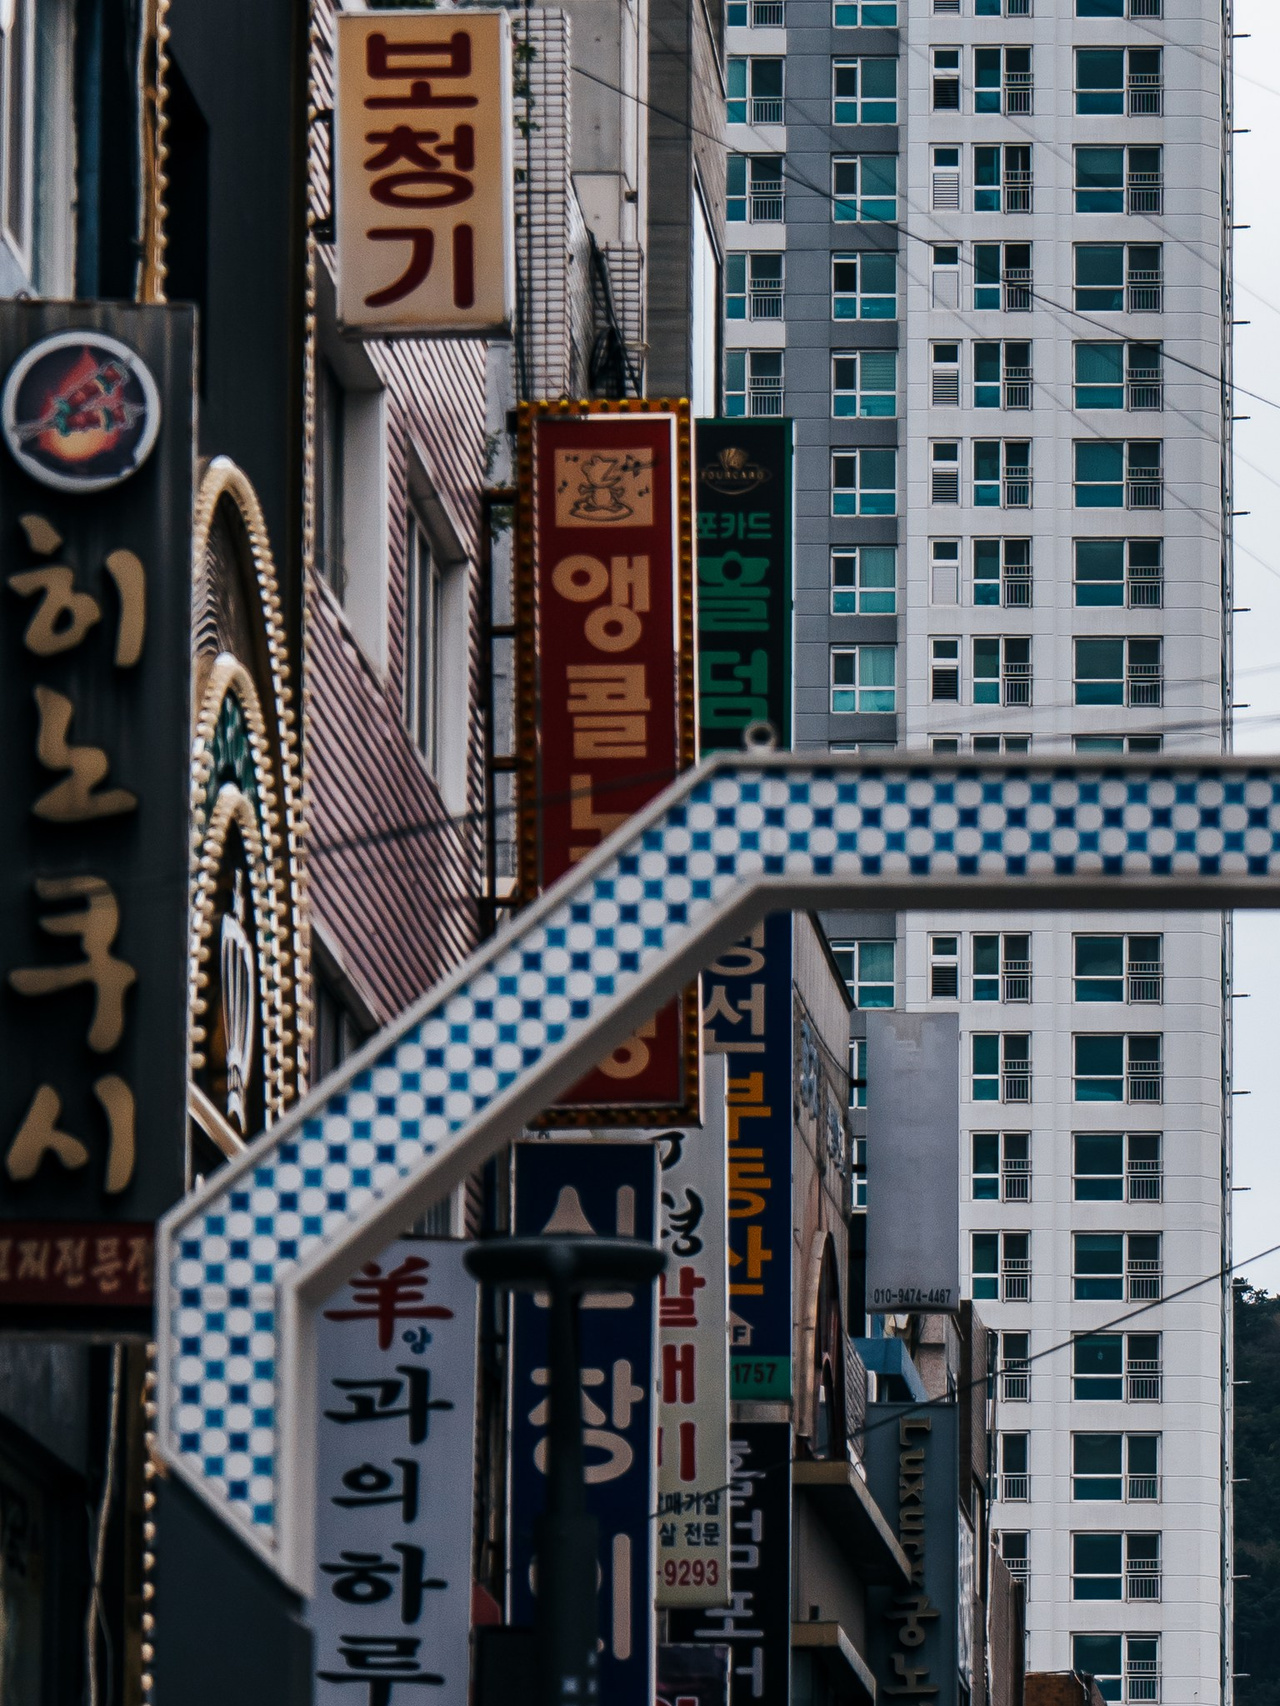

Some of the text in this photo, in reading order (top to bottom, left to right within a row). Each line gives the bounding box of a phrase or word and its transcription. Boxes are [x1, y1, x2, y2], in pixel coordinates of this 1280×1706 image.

[363, 30, 479, 311] 보청기
[697, 511, 773, 541] 포카드
[697, 551, 771, 728] 홀덤
[6, 513, 147, 1195] 히노쿠시
[873, 1288, 952, 1304] 010-9474-4467
